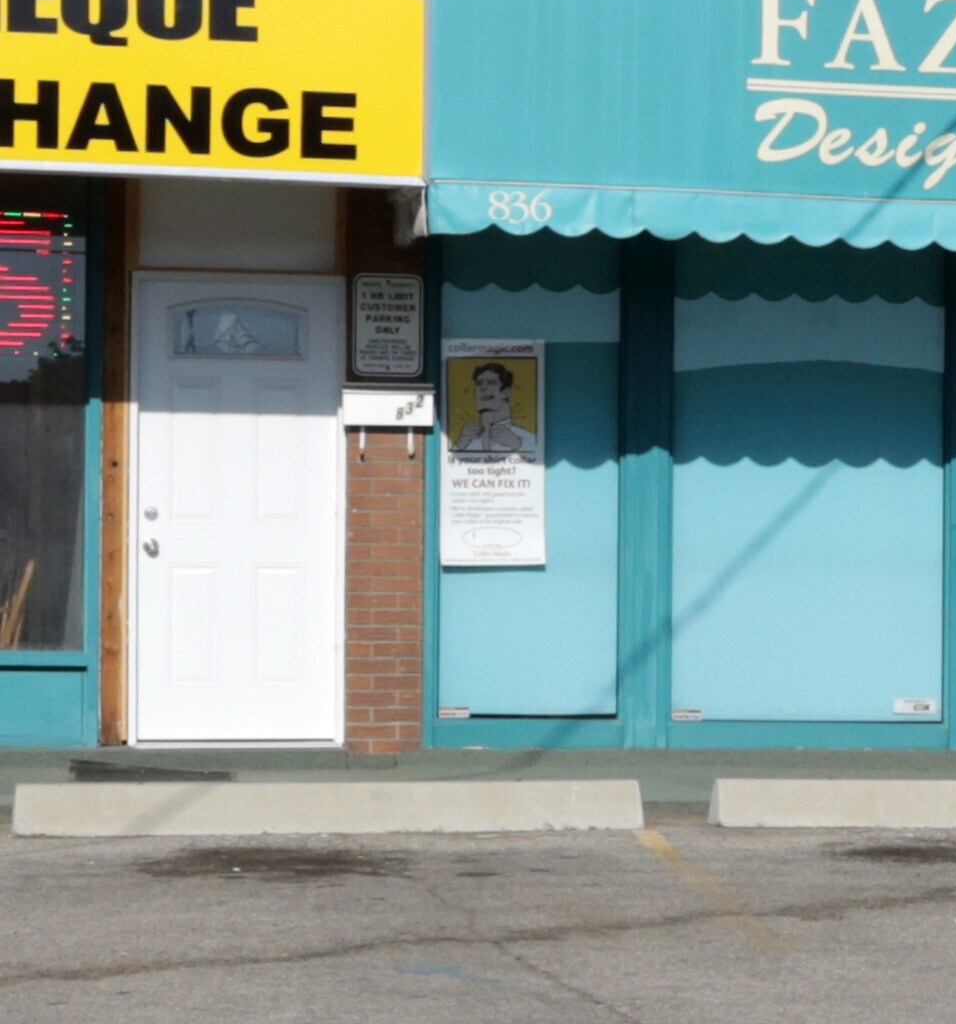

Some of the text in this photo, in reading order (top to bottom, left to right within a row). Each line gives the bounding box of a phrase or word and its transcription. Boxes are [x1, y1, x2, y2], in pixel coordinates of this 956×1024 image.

[486, 188, 554, 224] 836
[360, 303, 416, 312] CUSTOMER
[365, 314, 411, 323] PARKING
[374, 325, 401, 334] ONLY
[467, 466, 516, 477] too tight?
[452, 479, 469, 488] WE
[472, 479, 496, 488] CAN
[498, 479, 515, 488] FIX
